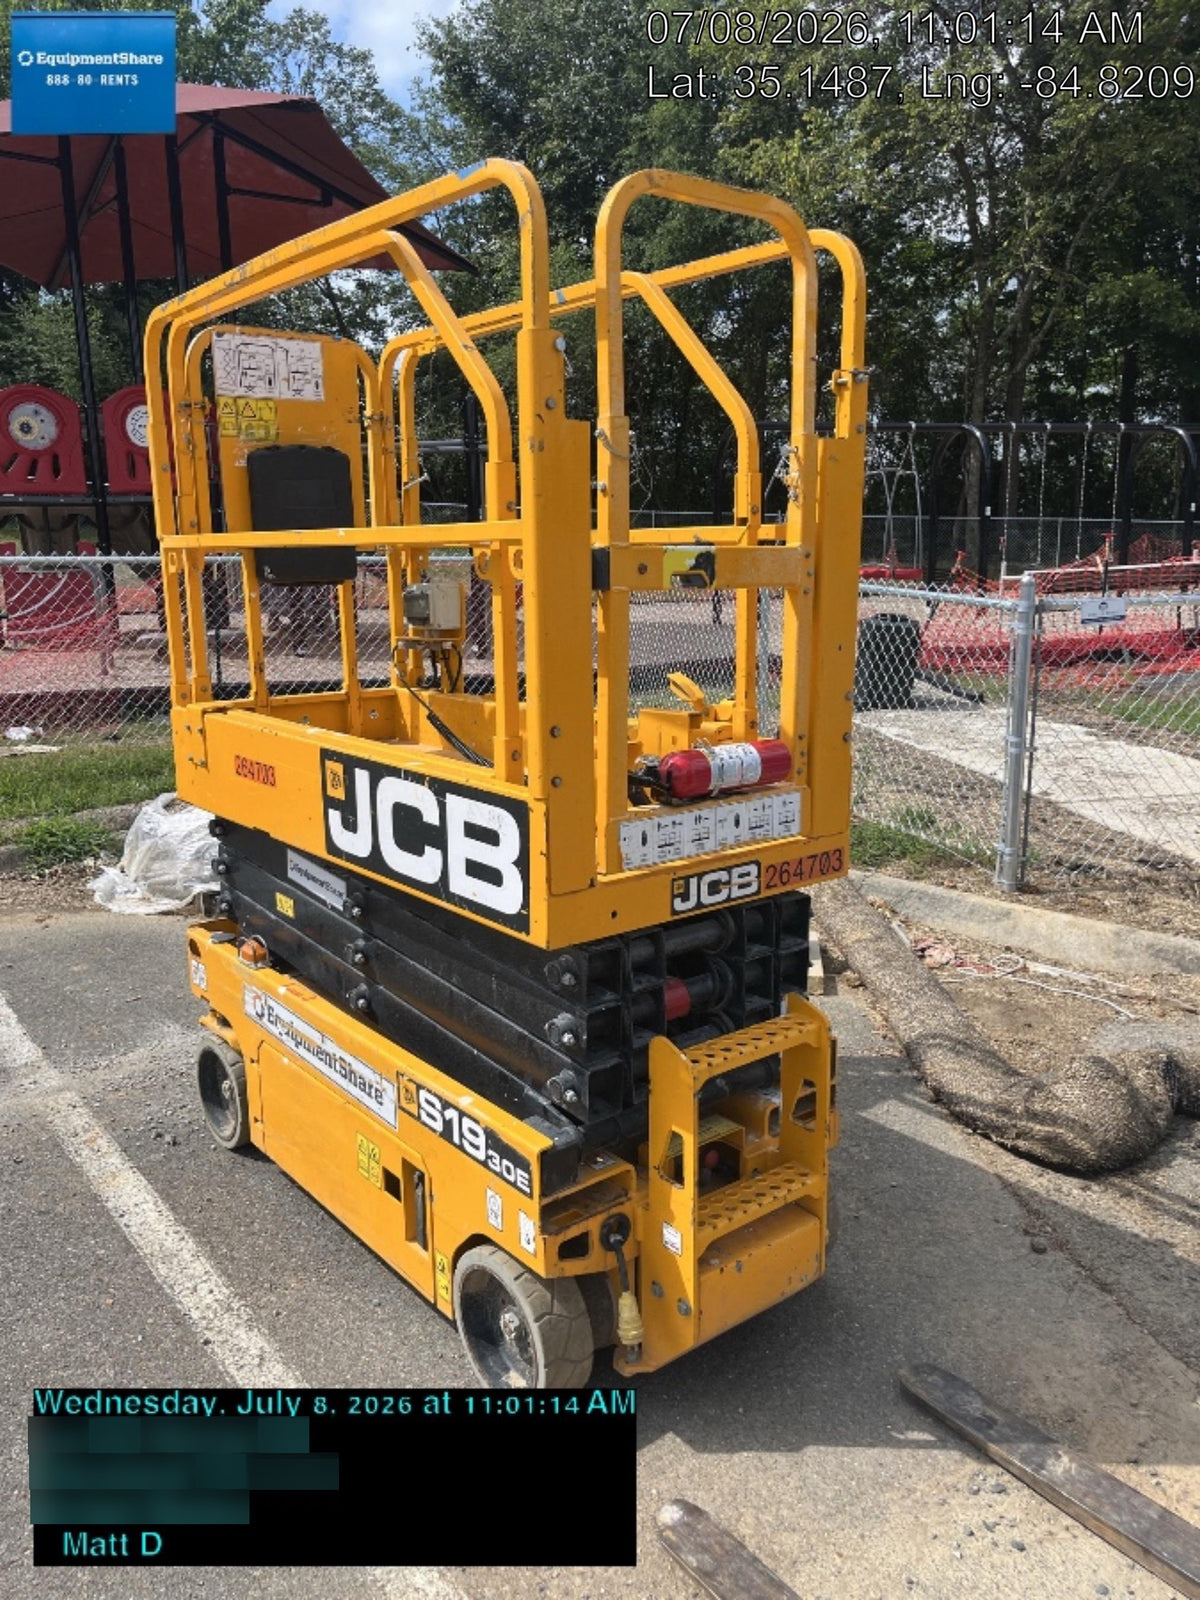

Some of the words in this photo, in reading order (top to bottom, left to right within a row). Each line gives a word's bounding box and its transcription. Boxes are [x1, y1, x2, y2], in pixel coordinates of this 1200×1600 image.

[234, 755, 276, 787] 264703
[328, 767, 524, 915] JCB
[673, 865, 759, 912] JCB
[765, 849, 843, 890] 264703
